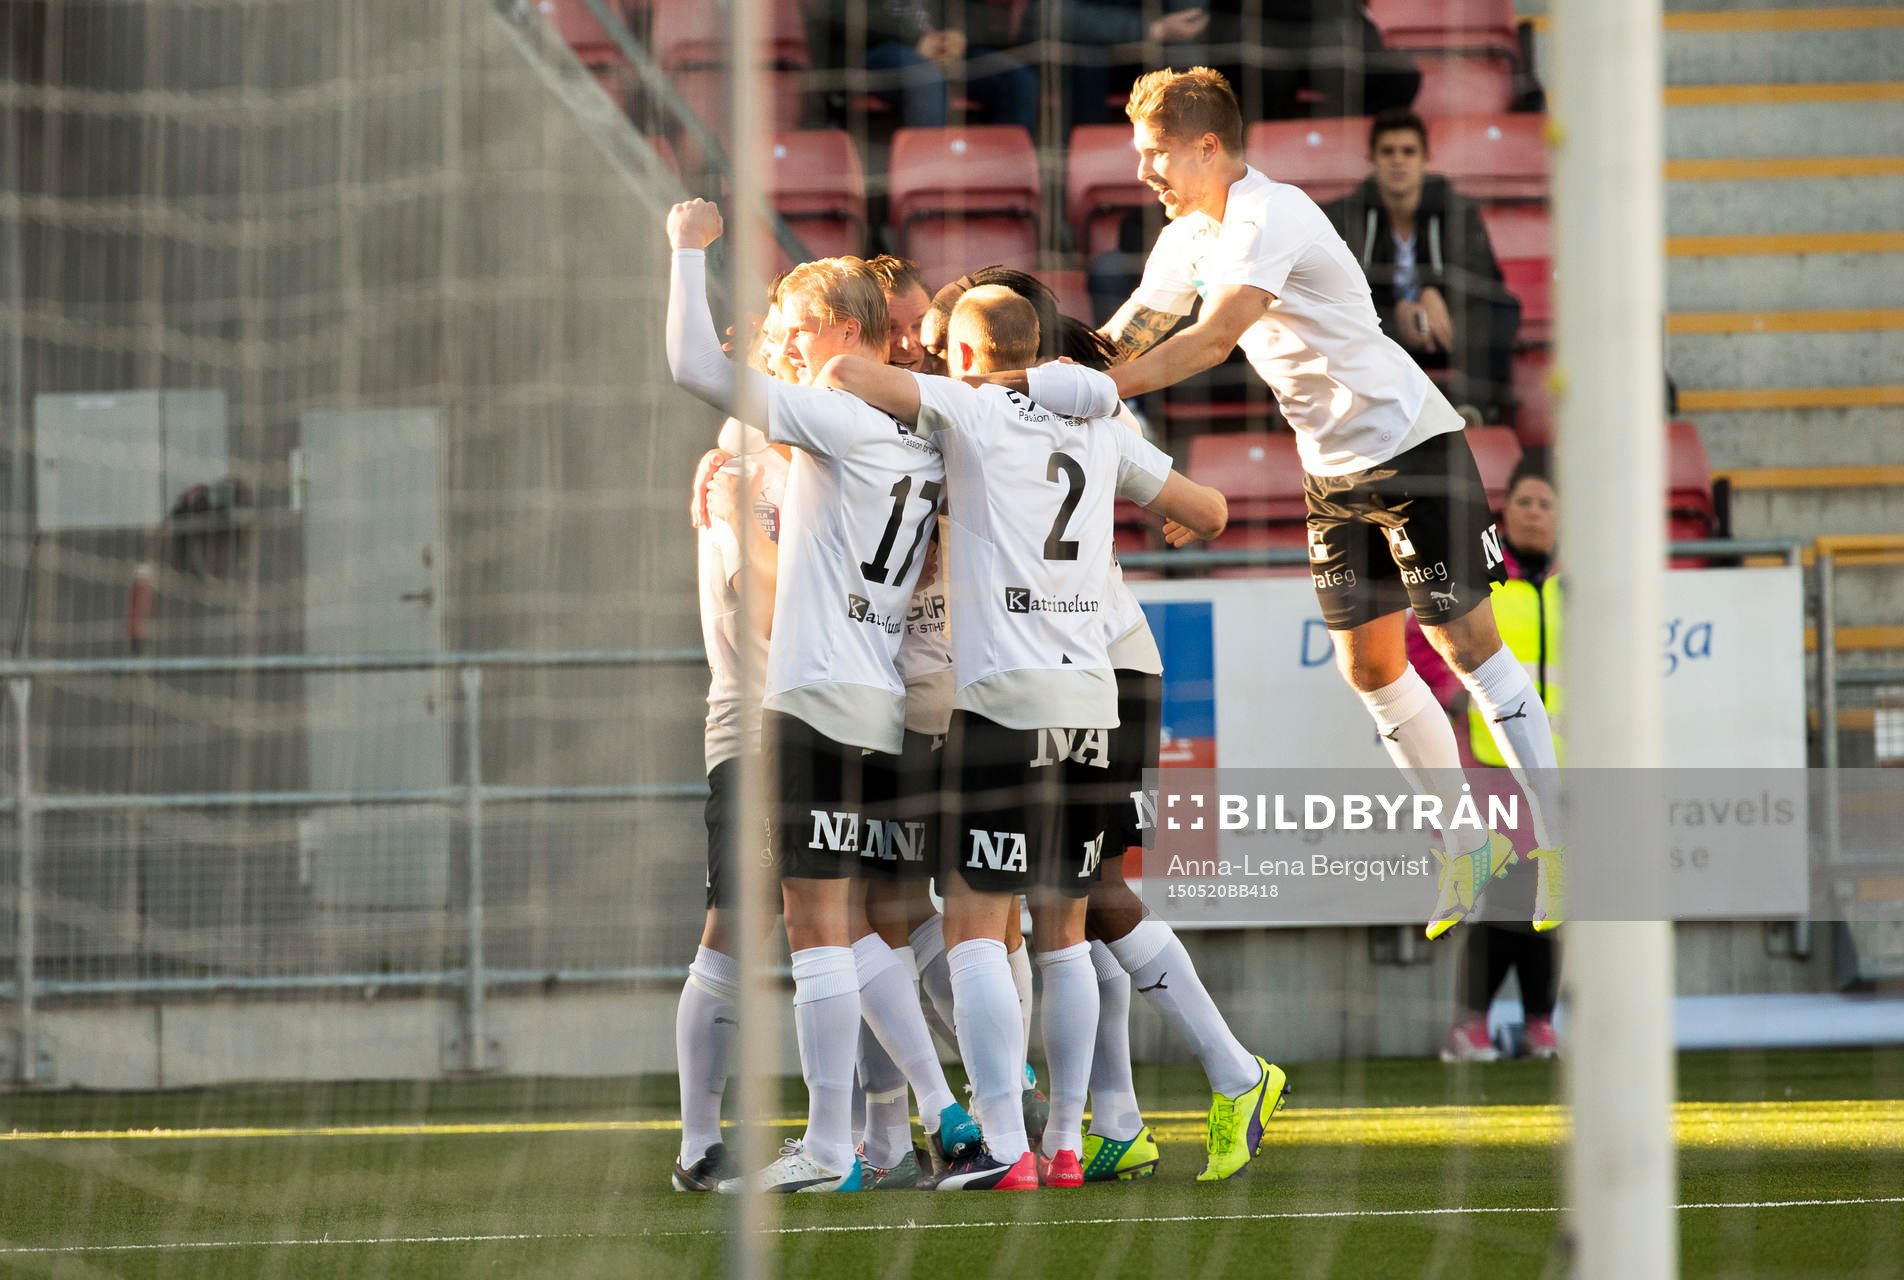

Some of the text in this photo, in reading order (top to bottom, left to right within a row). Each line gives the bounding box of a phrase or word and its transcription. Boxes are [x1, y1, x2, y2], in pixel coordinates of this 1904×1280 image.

[1043, 452, 1087, 561] 2
[859, 475, 941, 587] 17
[1437, 599, 1450, 612] 12
[808, 809, 859, 852] NA
[966, 828, 1028, 873] NA
